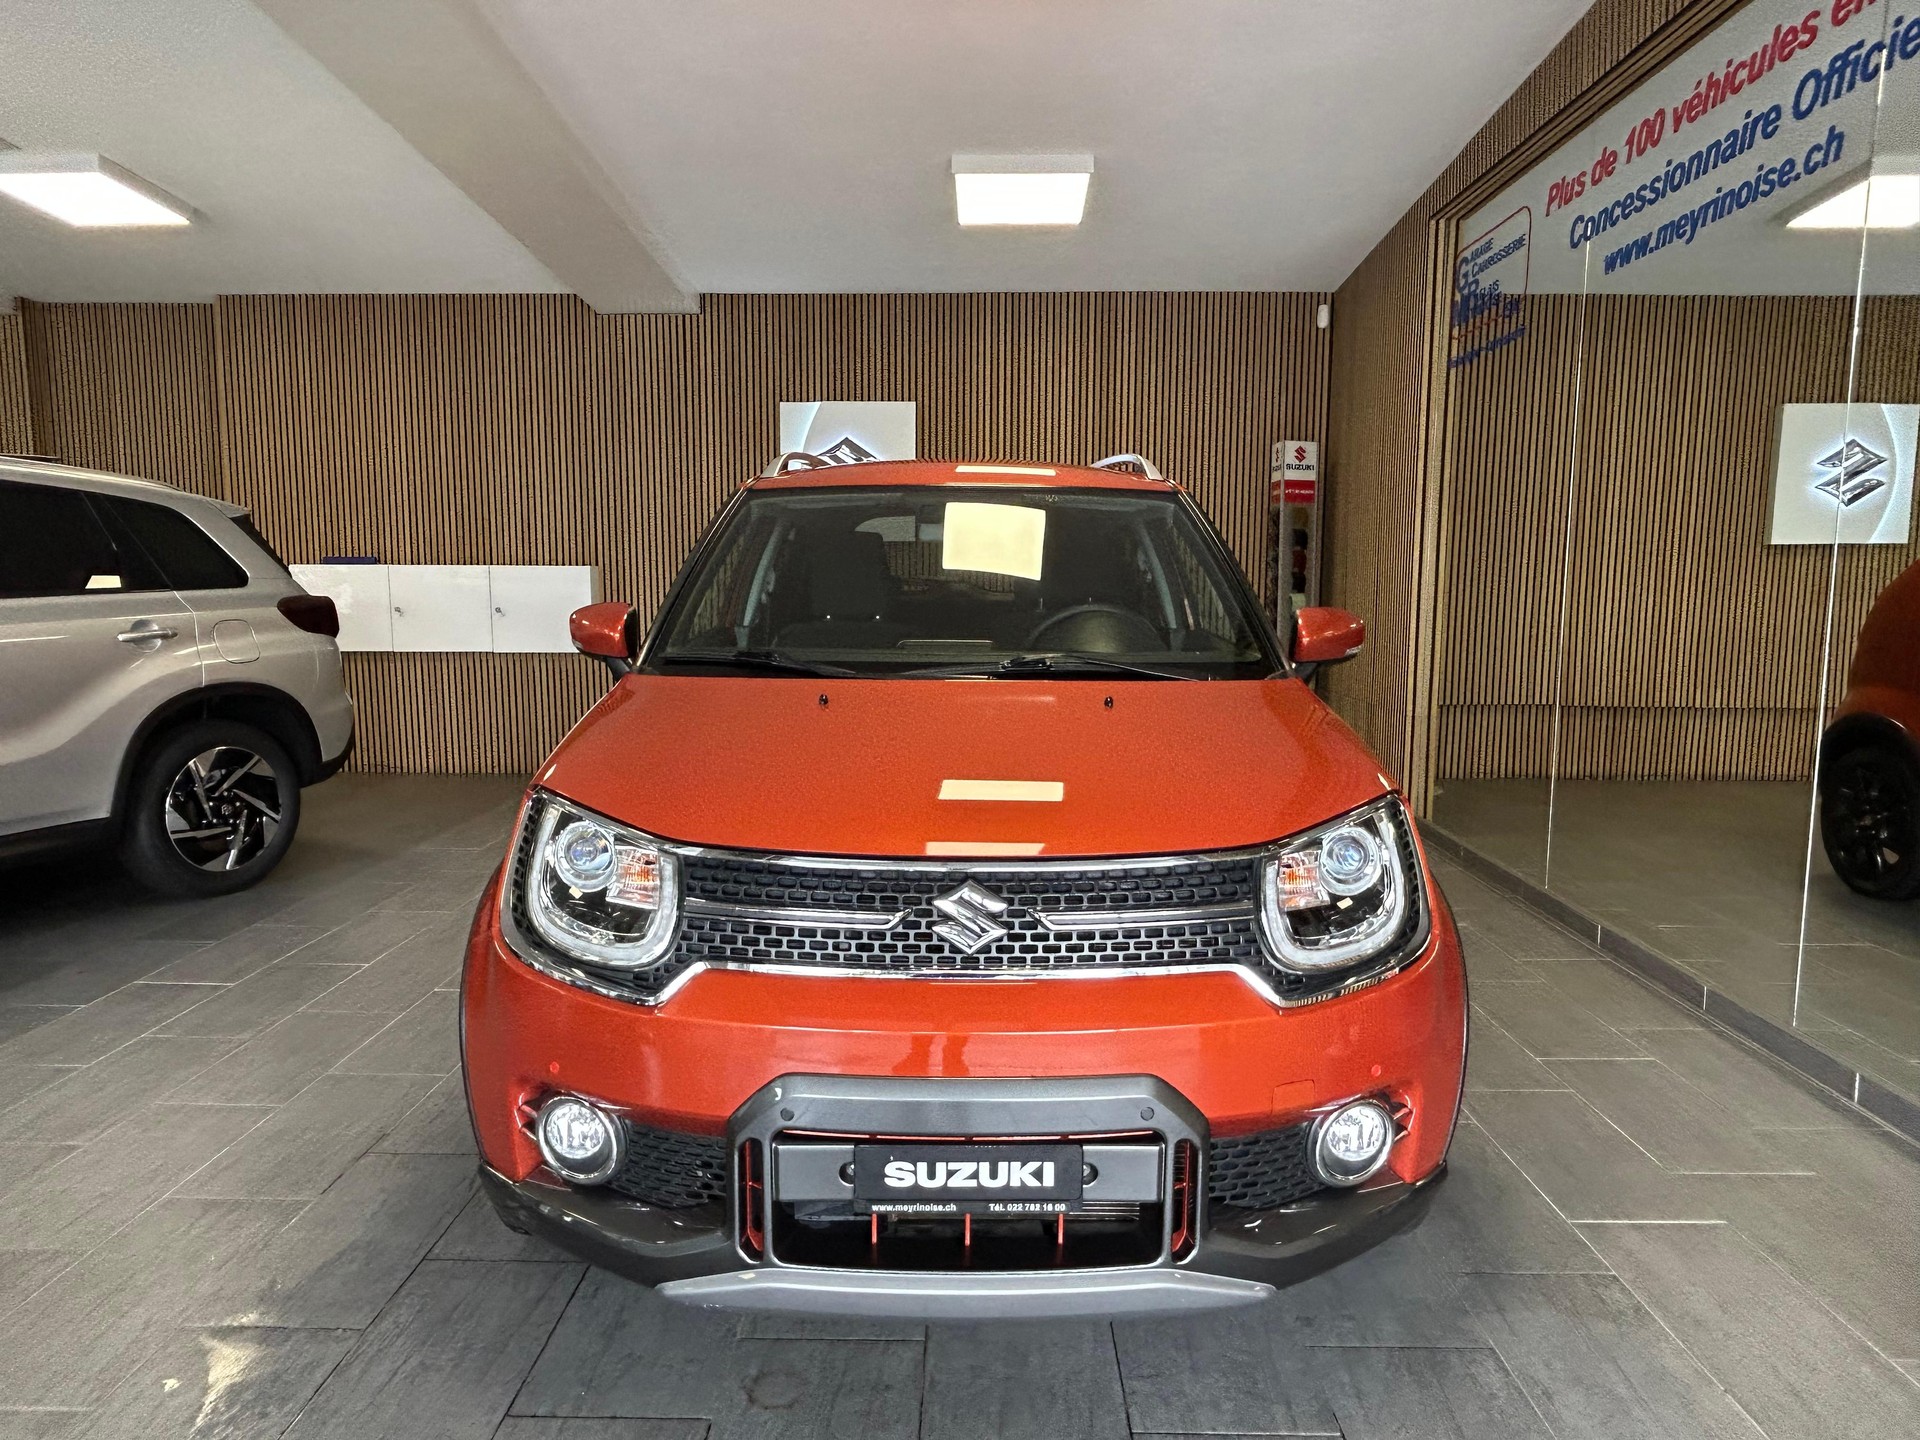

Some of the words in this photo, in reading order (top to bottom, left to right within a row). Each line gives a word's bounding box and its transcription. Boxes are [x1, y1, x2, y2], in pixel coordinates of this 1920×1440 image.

[1545, 171, 1587, 217] Plus
[1591, 146, 1617, 187] de
[1624, 108, 1665, 164] 100
[1673, 10, 1820, 133] véhicules
[1570, 103, 1781, 249] Concessionnaire
[1603, 125, 1845, 275] www.meyrinoise.ch
[871, 1203, 957, 1213] www.meyrinoise.ch
[1007, 1203, 1022, 1212] 022
[884, 1161, 1055, 1188] SUZUKI
